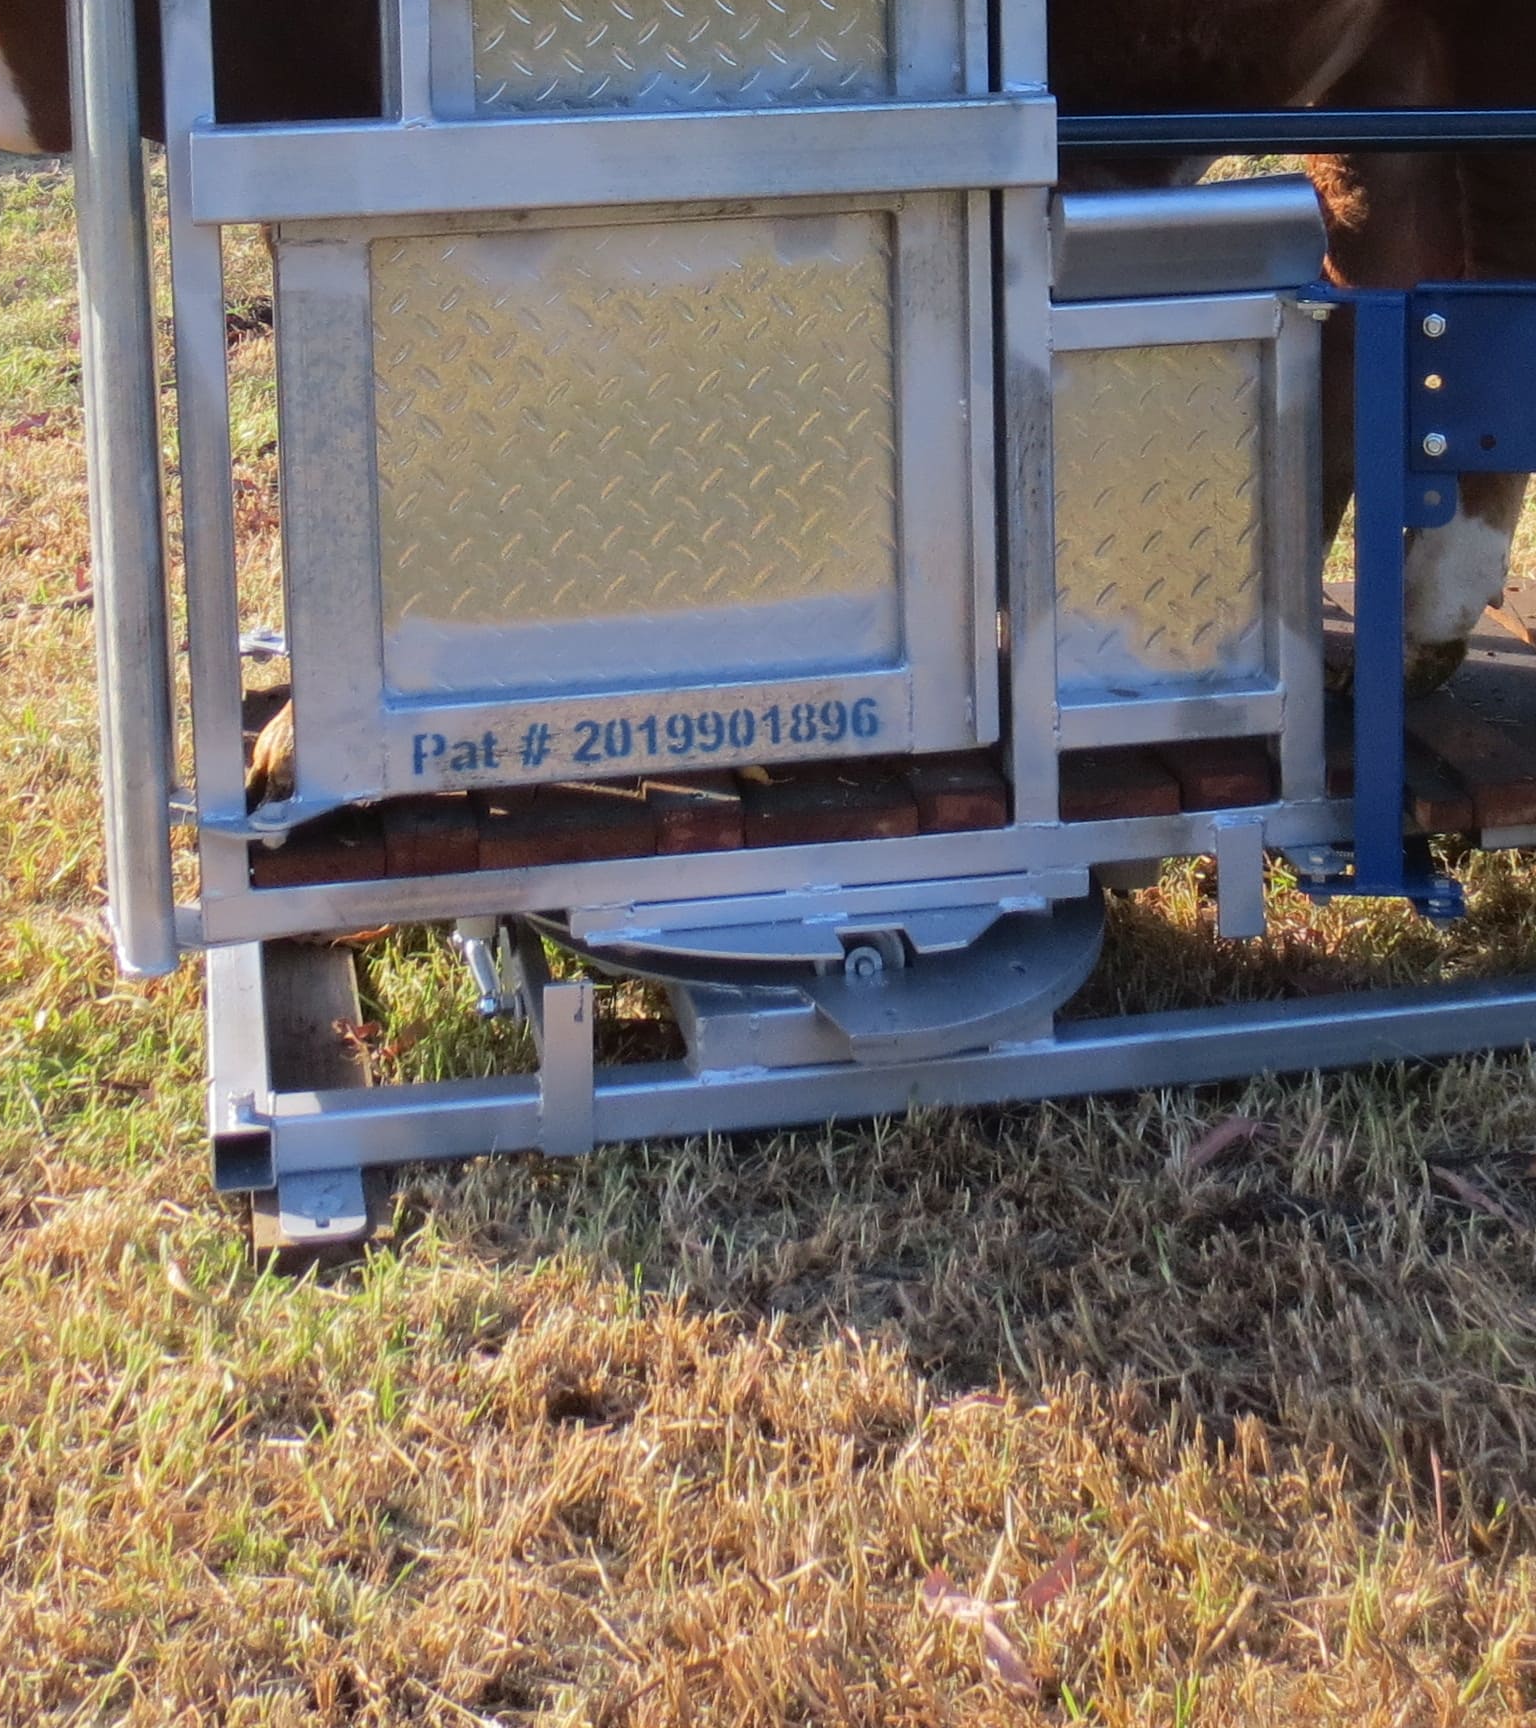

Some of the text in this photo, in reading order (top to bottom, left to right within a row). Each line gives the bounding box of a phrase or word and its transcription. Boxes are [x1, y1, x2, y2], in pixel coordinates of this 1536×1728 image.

[412, 697, 880, 775] Pat # 2019901896
